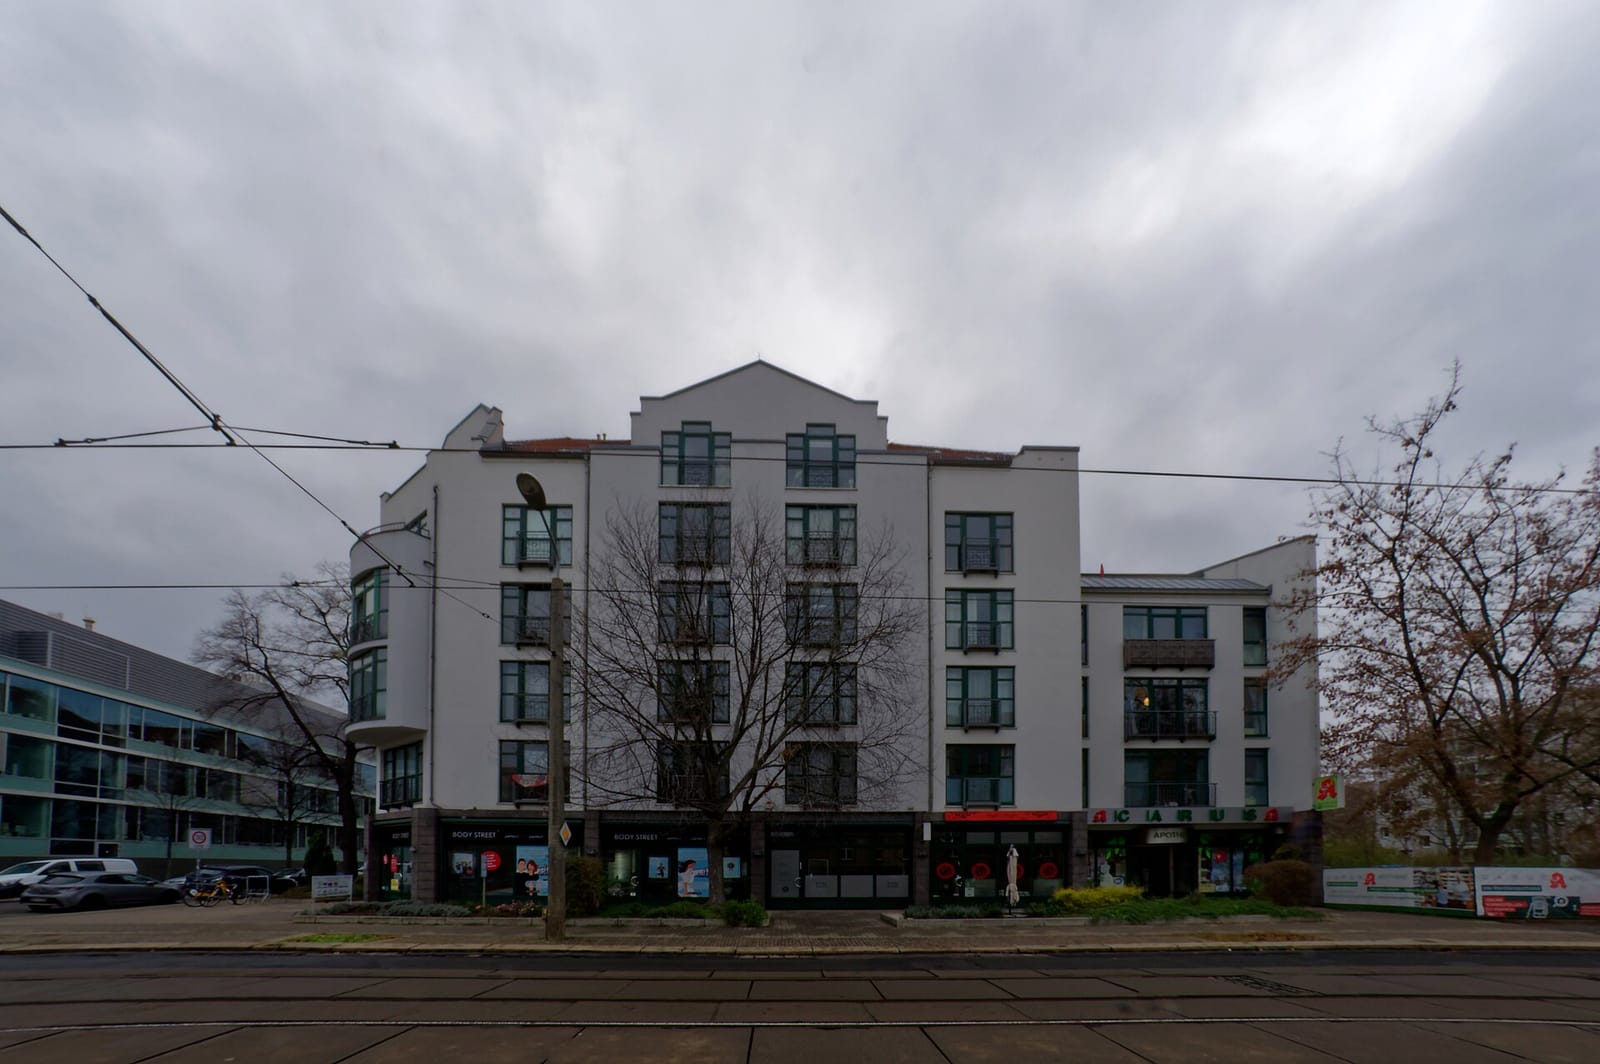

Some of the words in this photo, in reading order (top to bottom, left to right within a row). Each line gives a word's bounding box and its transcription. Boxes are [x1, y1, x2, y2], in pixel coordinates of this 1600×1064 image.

[451, 831, 473, 839] BODY
[473, 831, 497, 839] STREET
[613, 833, 634, 841] BODY
[635, 833, 658, 841] STREET
